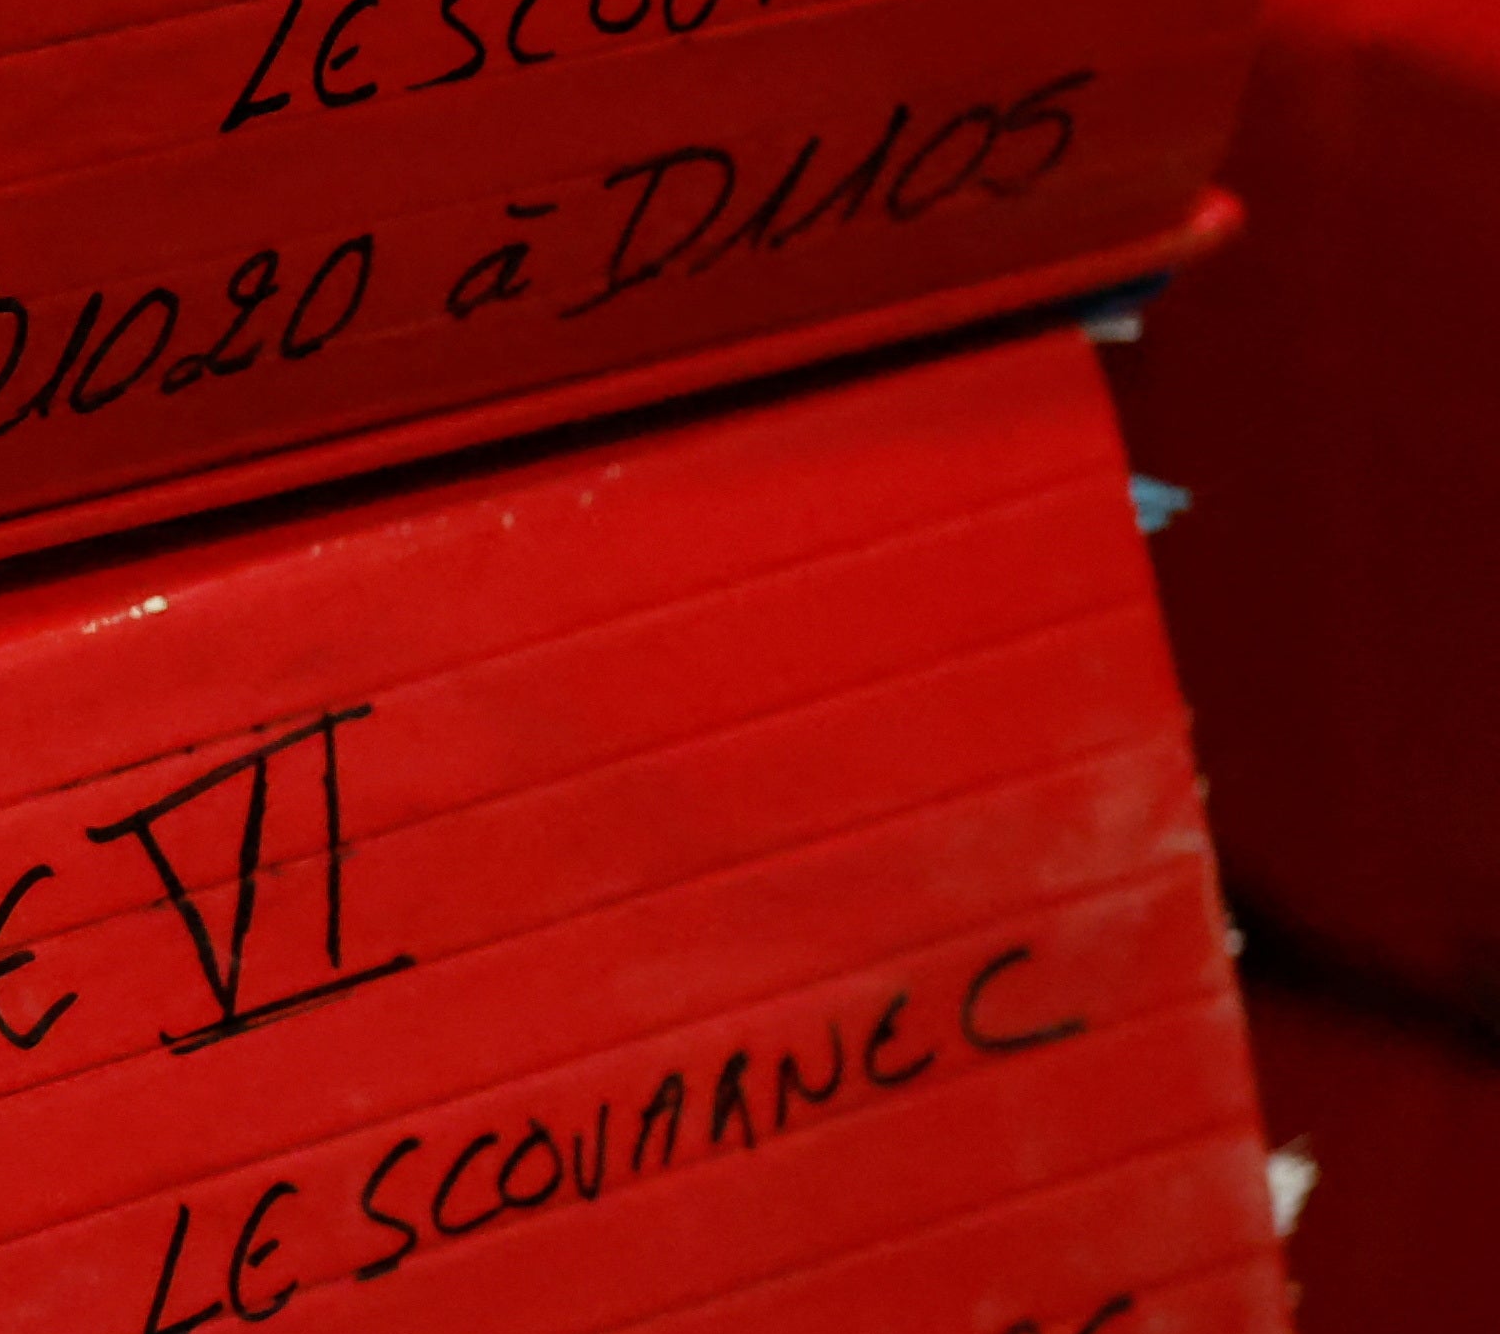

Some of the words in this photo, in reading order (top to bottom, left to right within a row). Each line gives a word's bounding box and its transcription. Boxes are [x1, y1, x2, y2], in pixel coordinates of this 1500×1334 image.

[446, 201, 558, 325] à
[557, 69, 1101, 325] D1105
[86, 704, 417, 1056] VI
[352, 947, 1087, 1281] SCOUARNEC
